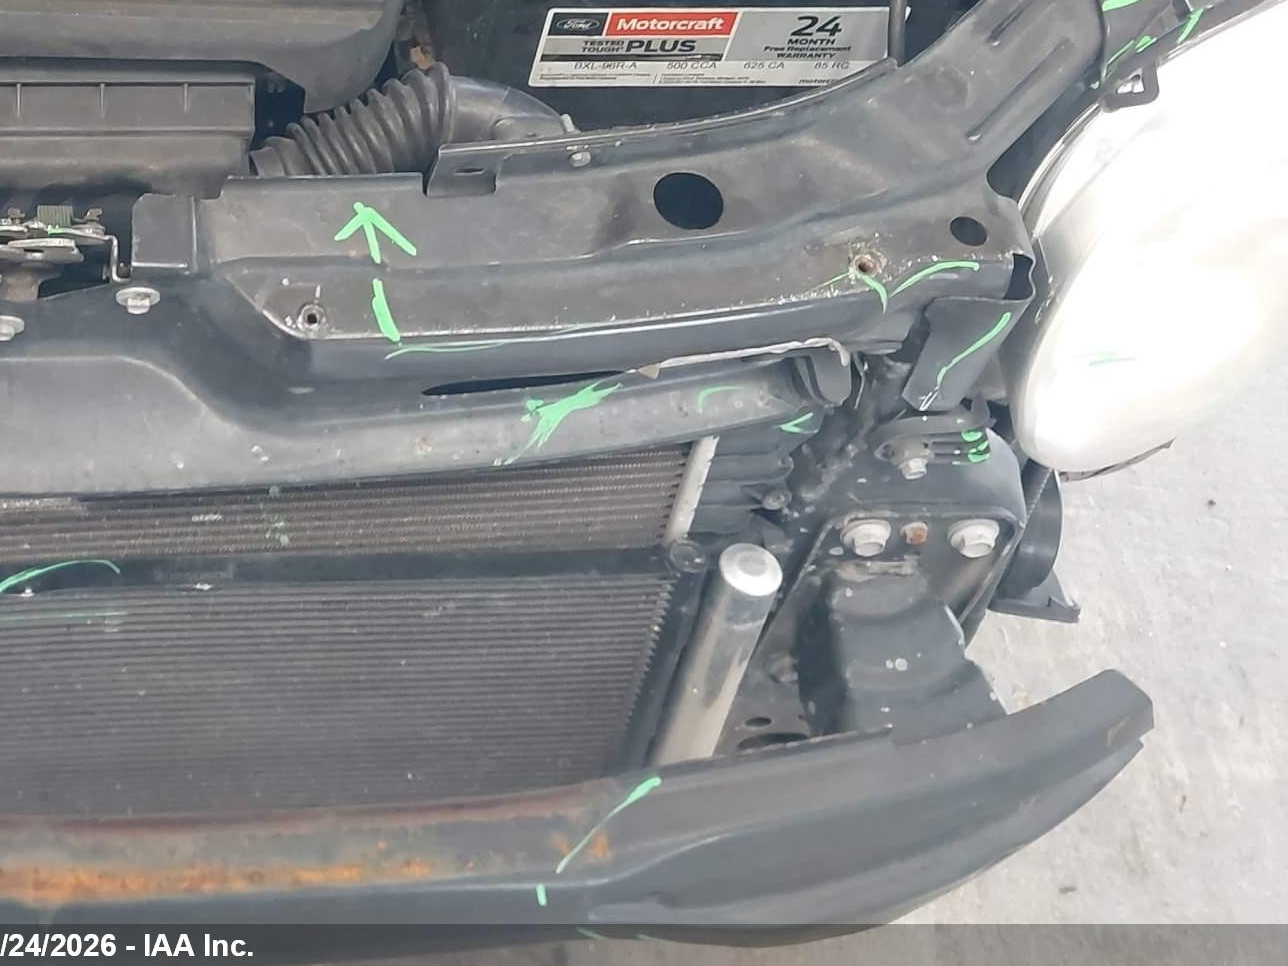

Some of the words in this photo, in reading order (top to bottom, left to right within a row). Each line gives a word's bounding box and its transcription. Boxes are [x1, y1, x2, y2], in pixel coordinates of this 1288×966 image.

[563, 19, 592, 30] Ford
[616, 17, 725, 31] Motorcraft
[790, 15, 843, 37] 24
[625, 39, 697, 53] PLUS
[691, 62, 718, 70] CCA
[767, 61, 786, 70] CA
